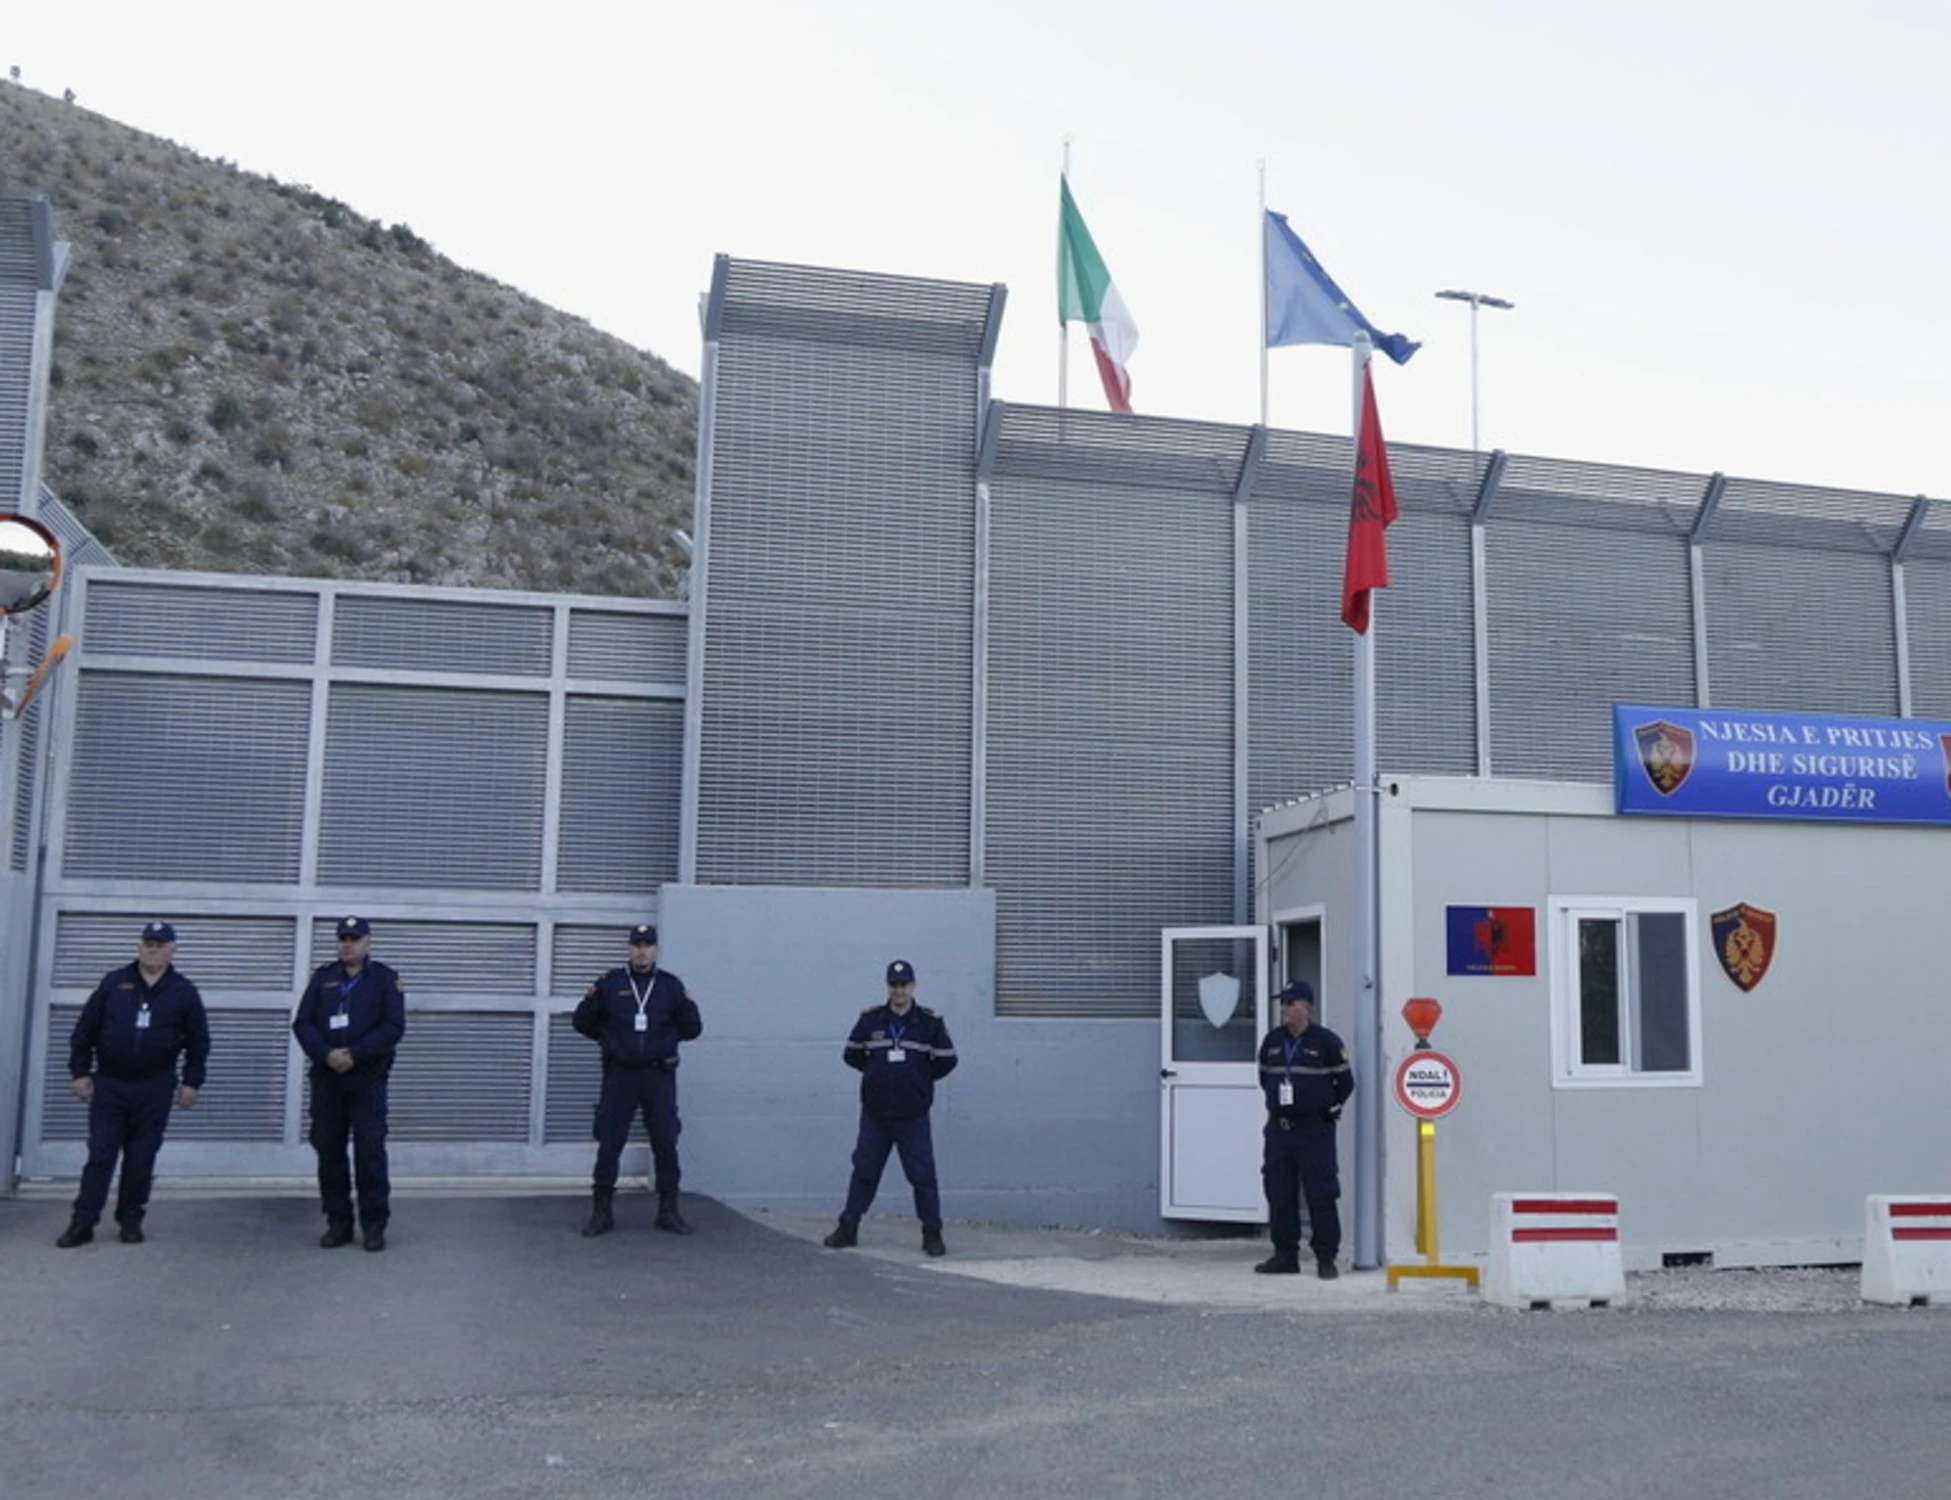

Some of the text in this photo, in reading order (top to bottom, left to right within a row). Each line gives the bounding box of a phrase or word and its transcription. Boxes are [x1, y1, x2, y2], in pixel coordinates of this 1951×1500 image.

[1700, 719, 1934, 750] NJESIA E PRITJES
[1727, 751, 1918, 780] DHE SIGURISË
[1766, 783, 1876, 809] GJADËR
